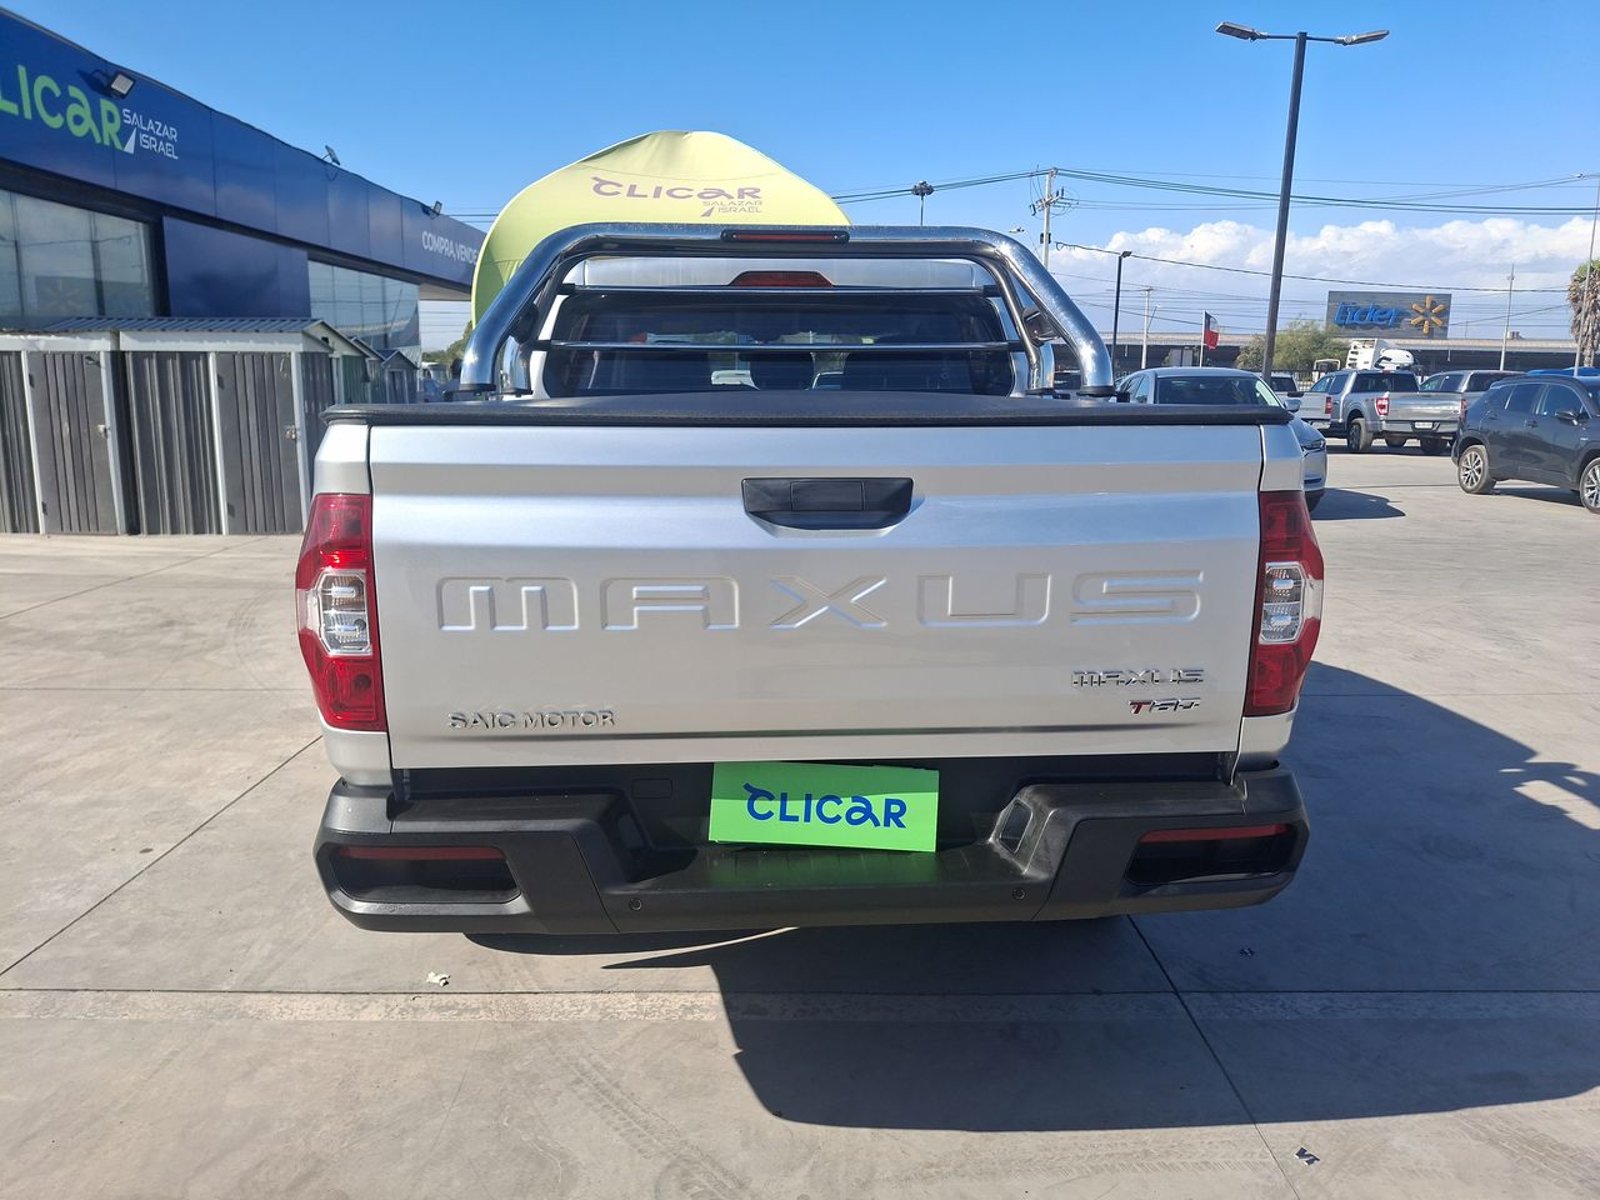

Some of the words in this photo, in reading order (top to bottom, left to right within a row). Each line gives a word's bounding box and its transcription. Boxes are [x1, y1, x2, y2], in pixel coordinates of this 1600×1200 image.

[122, 109, 178, 142] SALAZAR
[139, 132, 179, 160] ISRAEL
[592, 176, 761, 200] CLICAR
[436, 570, 1204, 631] MAXUS
[1072, 669, 1204, 687] MAXUS
[448, 711, 516, 729] SAIC
[522, 709, 616, 729] MOTOR
[742, 782, 907, 829] CLICAR
